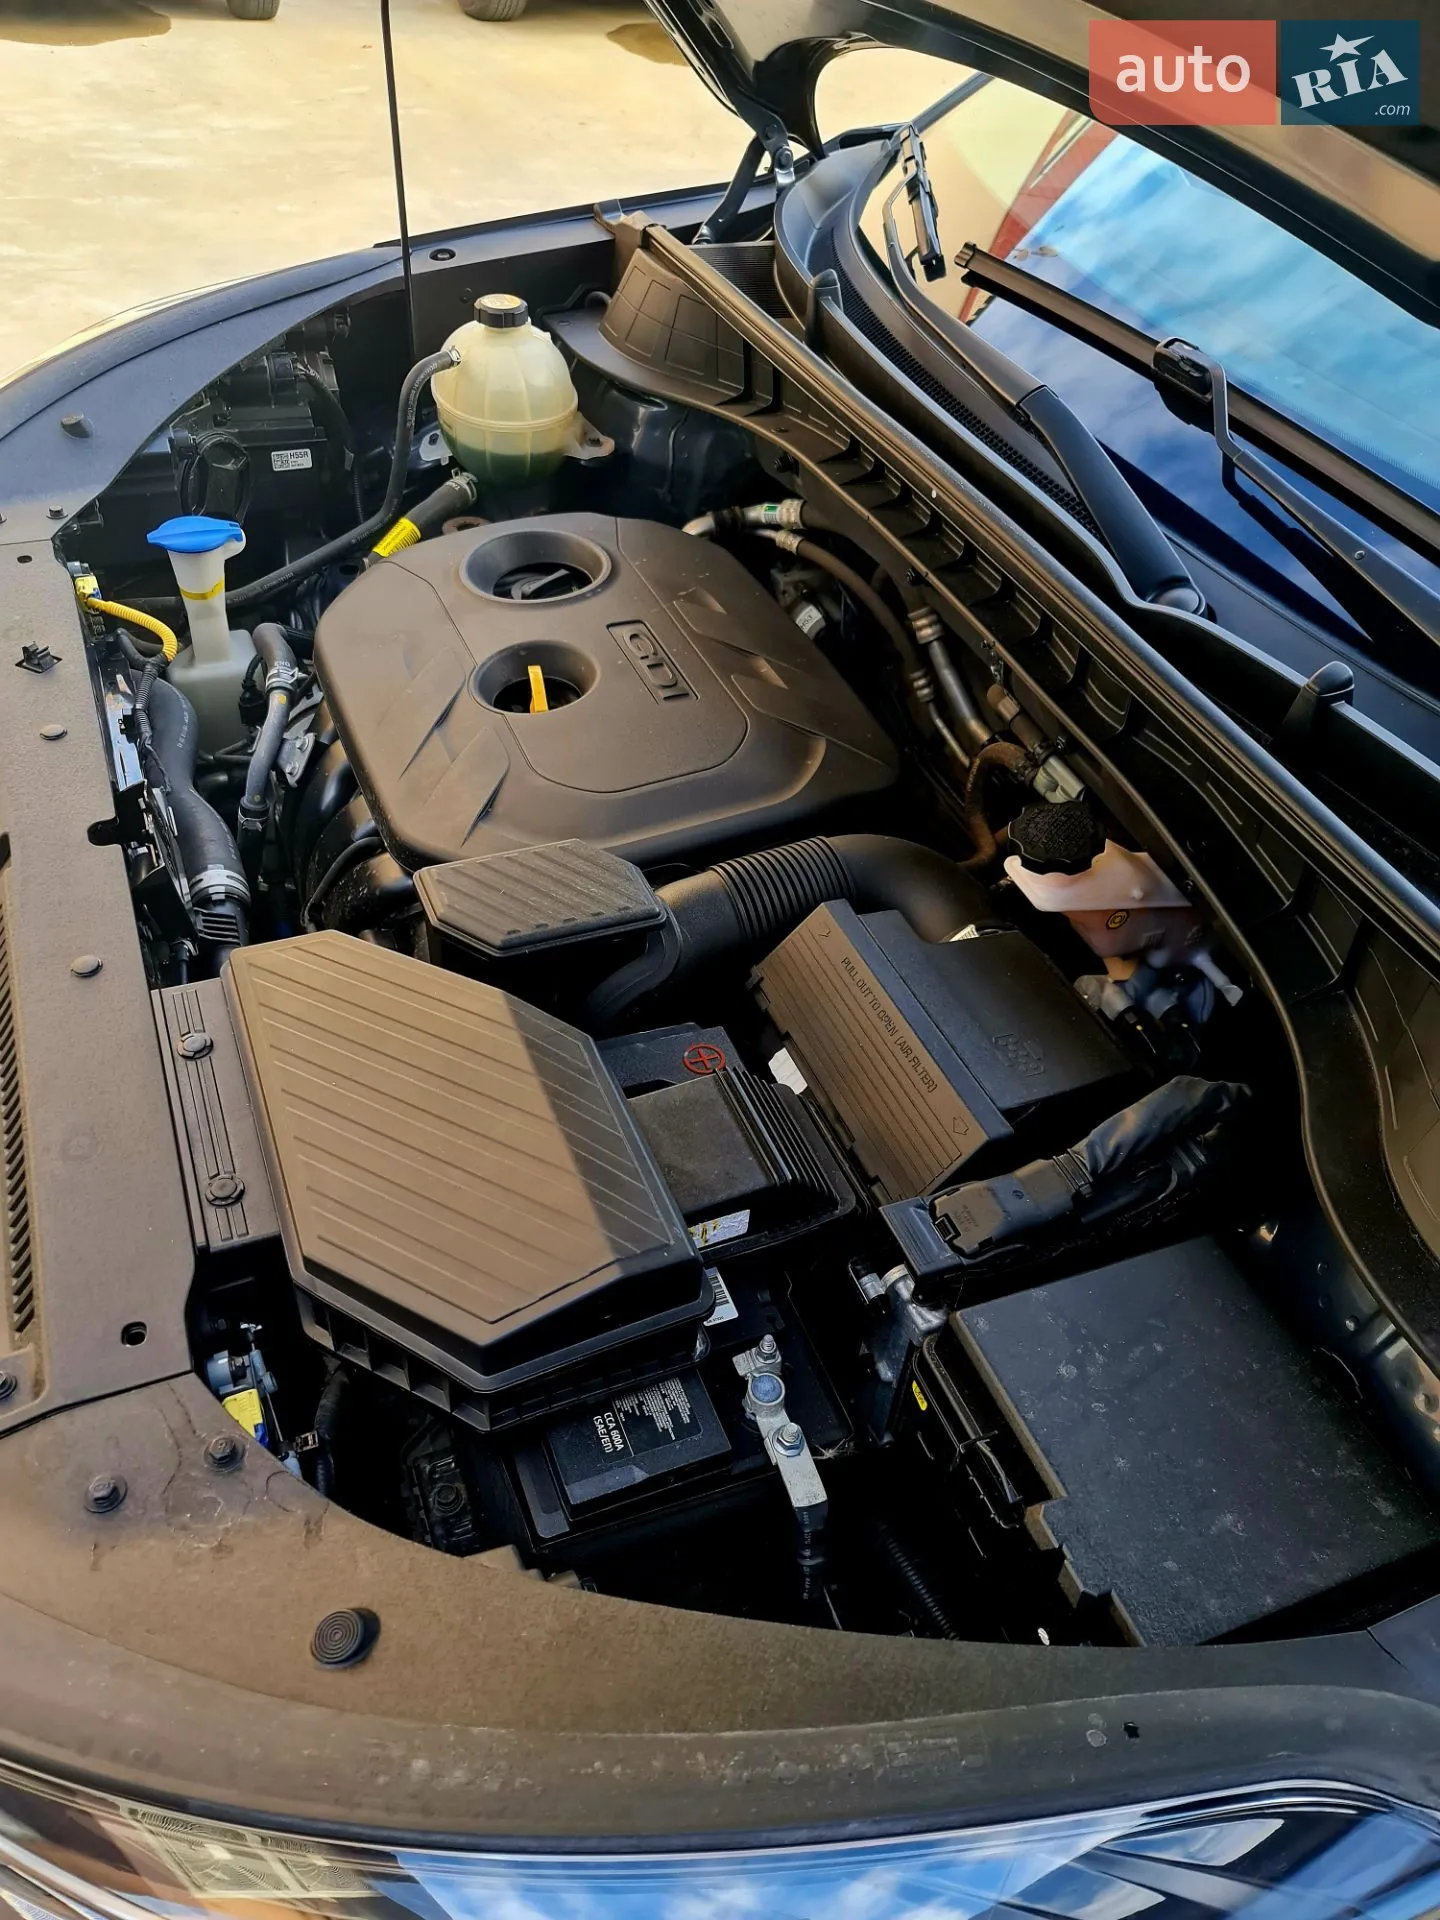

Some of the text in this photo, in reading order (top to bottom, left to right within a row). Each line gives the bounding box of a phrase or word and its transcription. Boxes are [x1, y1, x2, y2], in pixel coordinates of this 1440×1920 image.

[622, 628, 690, 701] GDI
[841, 957, 938, 1093] PULL OUT TO OPEN (AIR FILTER)
[603, 1412, 625, 1452] CCA 600A
